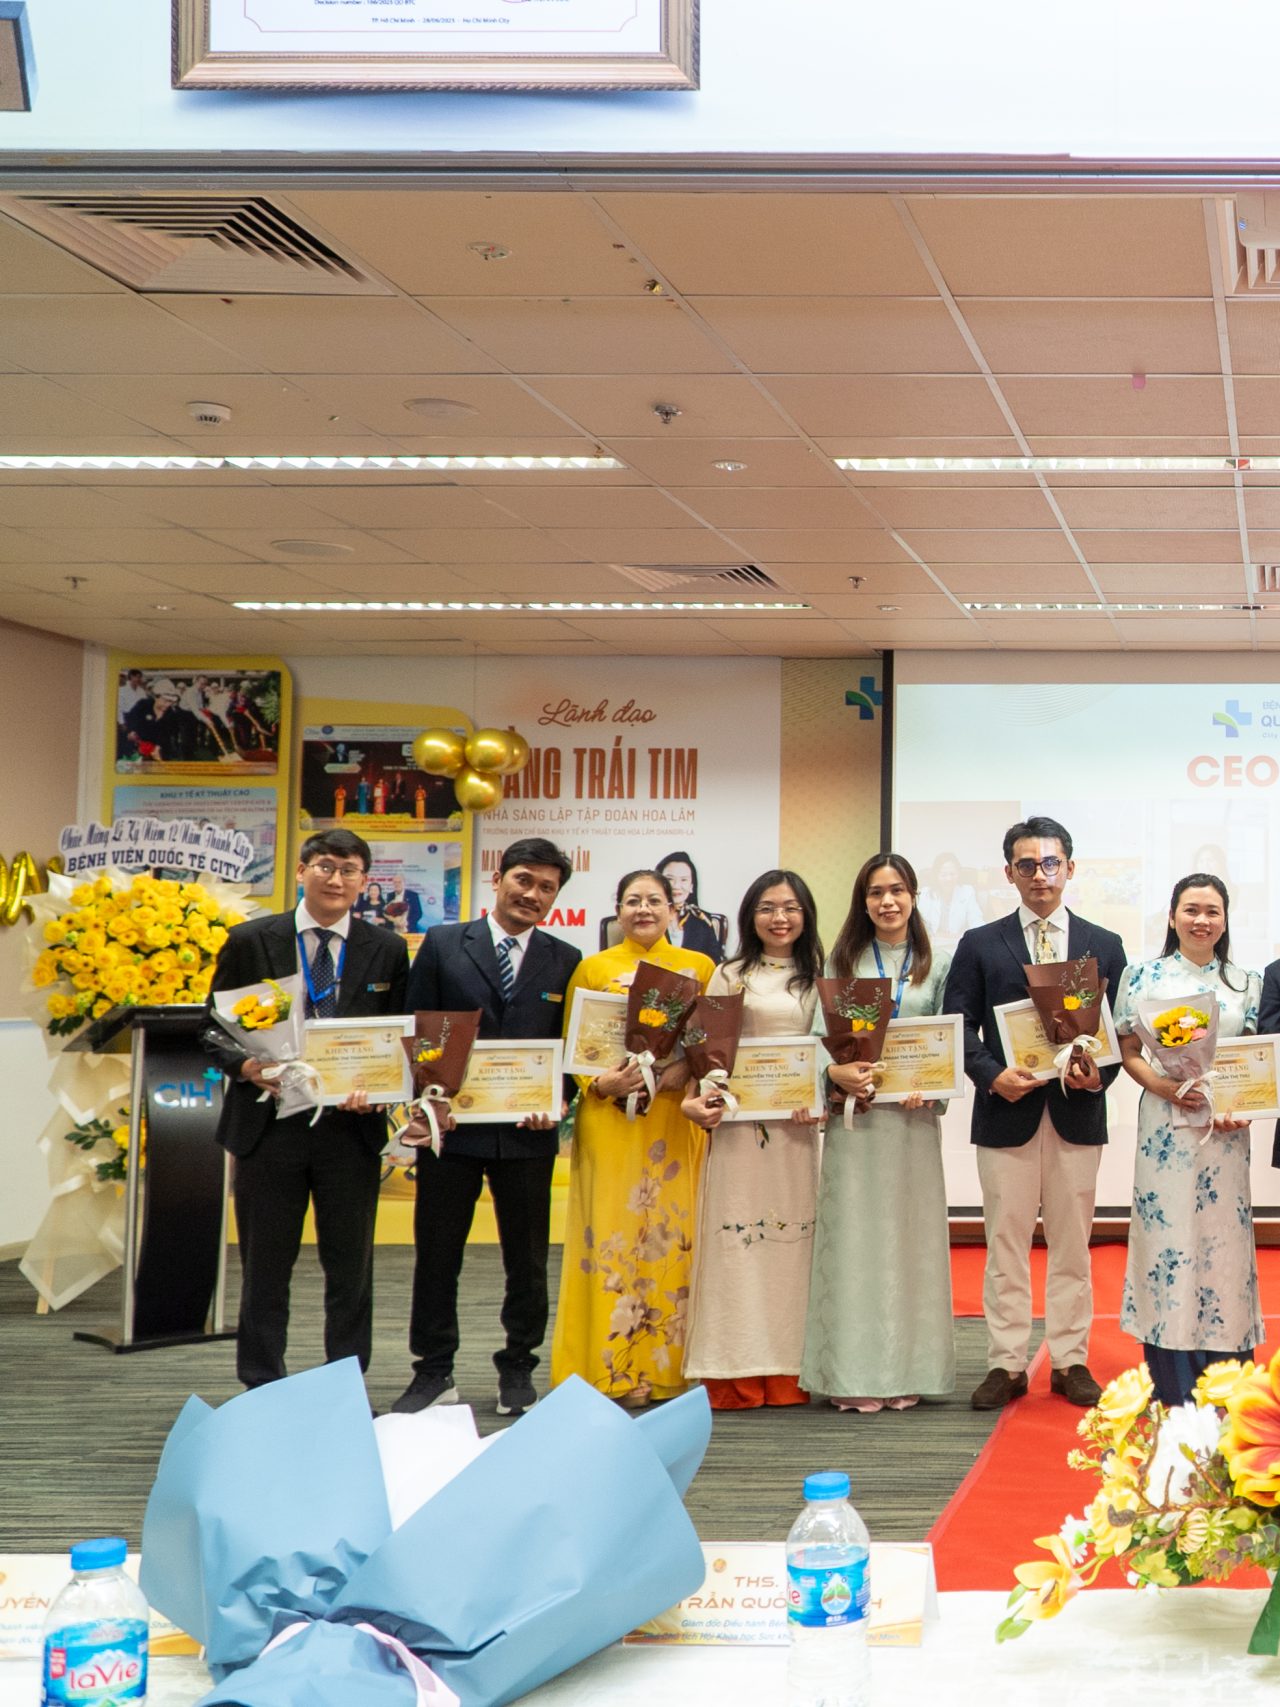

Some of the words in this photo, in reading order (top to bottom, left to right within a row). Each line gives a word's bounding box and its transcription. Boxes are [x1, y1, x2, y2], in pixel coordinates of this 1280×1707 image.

[538, 698, 609, 727] Lãnh
[612, 699, 657, 727] đạo
[573, 735, 636, 799] TRÁI
[648, 748, 698, 799] TIM
[1186, 755, 1280, 788] CEO
[483, 807, 508, 822] NHÀ
[513, 807, 545, 822] SÁNG
[550, 806, 572, 824] LẬP
[577, 806, 600, 824] TẬP
[605, 806, 638, 822] ĐOÀN
[642, 808, 666, 822] HOA
[671, 806, 695, 822] LÂM
[67, 850, 107, 873] BỆNH
[112, 848, 144, 869] VIỆN
[149, 846, 183, 865] QUỐC
[188, 848, 206, 869] TẾ
[210, 856, 242, 880] CITY
[153, 1081, 213, 1109] CIH
[734, 1576, 779, 1588] THS.
[69, 1660, 139, 1690] laVie
